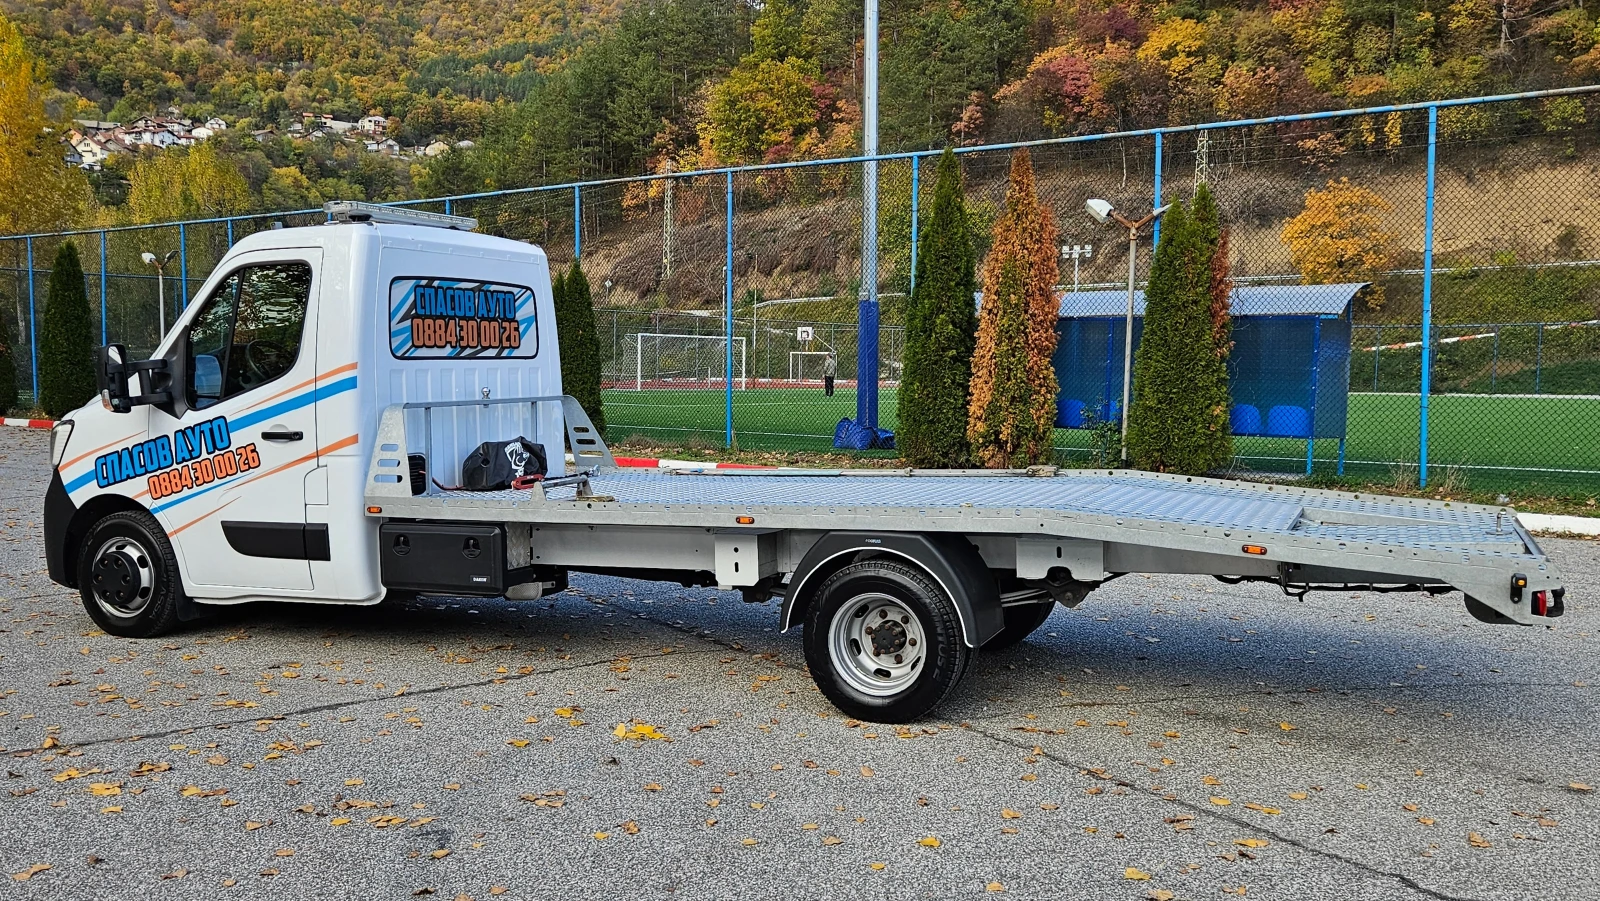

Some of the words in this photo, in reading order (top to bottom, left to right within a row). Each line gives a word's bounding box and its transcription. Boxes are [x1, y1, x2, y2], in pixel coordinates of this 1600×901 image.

[415, 286, 475, 316] СПАСОВ
[477, 290, 516, 318] АУТО
[412, 317, 457, 348] 0884
[458, 318, 479, 348] 30
[480, 319, 500, 348] 00
[501, 320, 520, 349] 26
[95, 435, 173, 488] СПАСОВ
[174, 415, 231, 465] АУТО
[148, 465, 193, 500] 0884
[191, 458, 214, 486] 30
[213, 450, 237, 479] 00
[236, 443, 260, 472] 26
